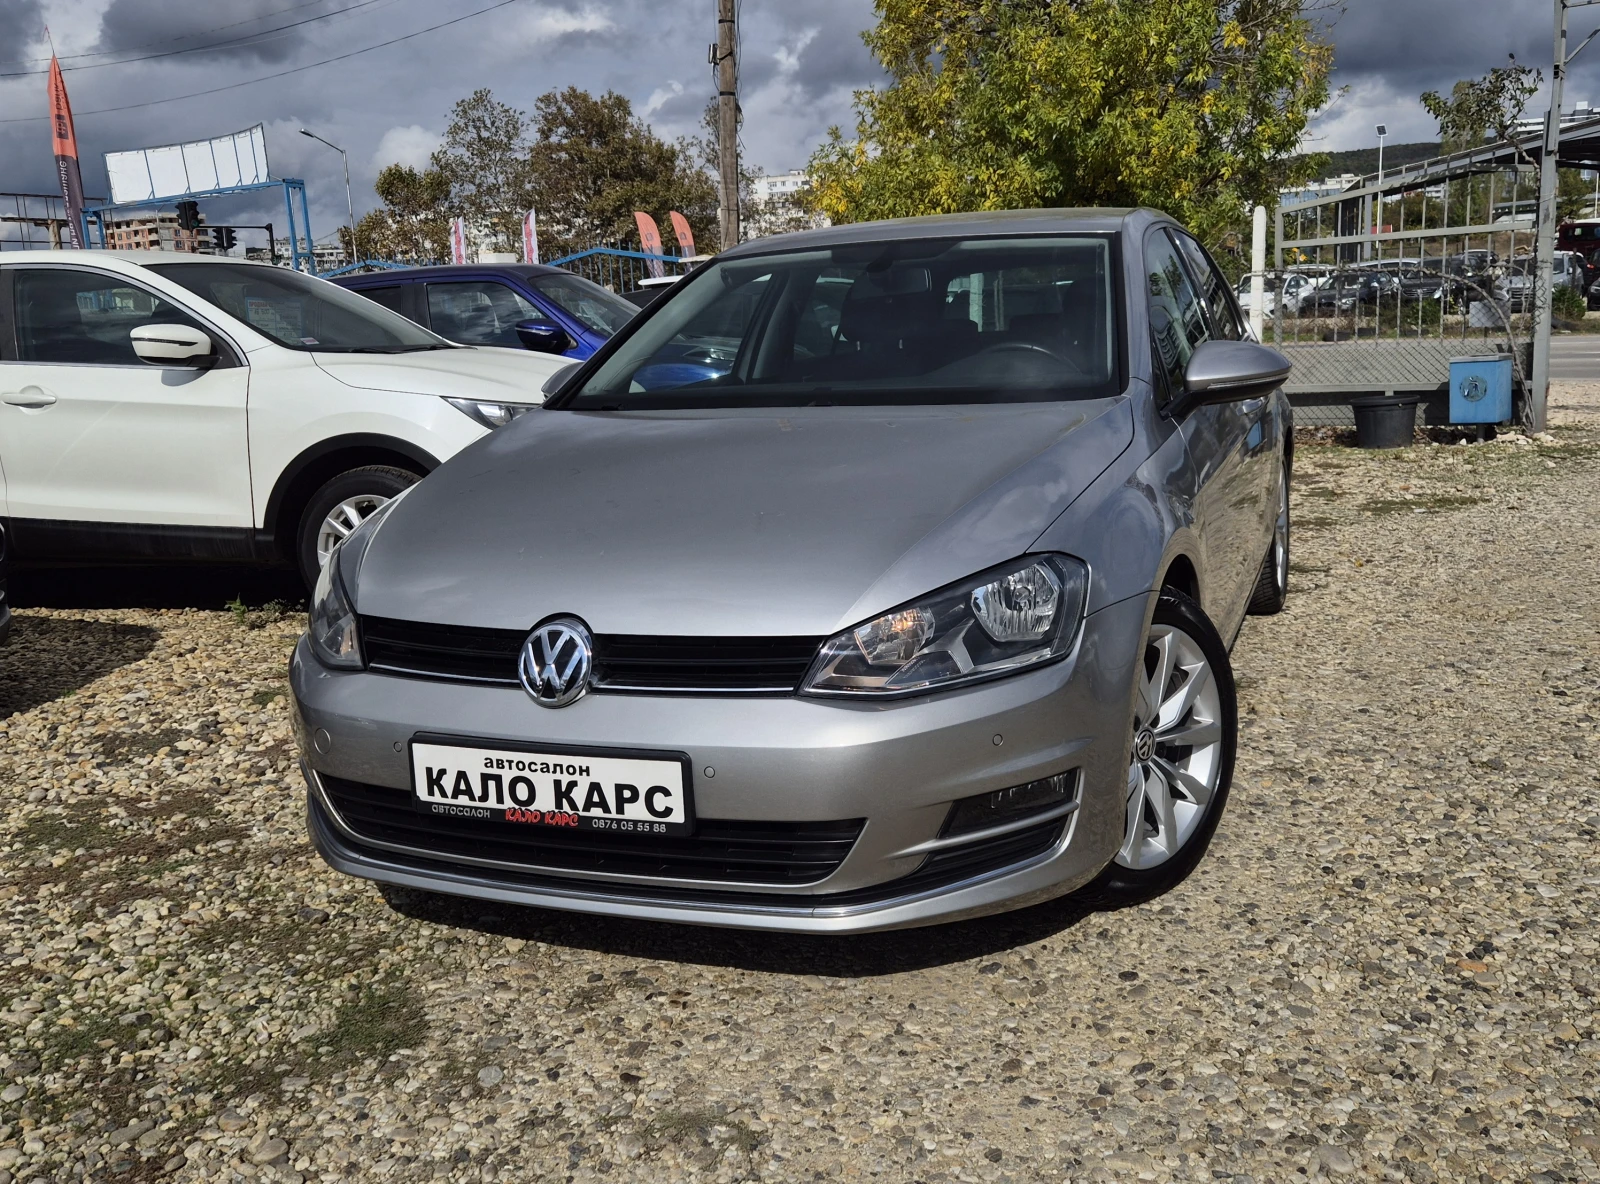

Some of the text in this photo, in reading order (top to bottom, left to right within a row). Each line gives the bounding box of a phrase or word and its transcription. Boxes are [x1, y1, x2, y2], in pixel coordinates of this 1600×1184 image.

[483, 756, 591, 777] автосалон
[425, 766, 675, 819] КАЛО КАРС
[505, 807, 541, 824] КАЛО
[544, 810, 580, 828] КАРС
[591, 818, 618, 830] 0876
[620, 820, 634, 831] 05
[636, 822, 650, 832] 55
[652, 823, 667, 834] 88
